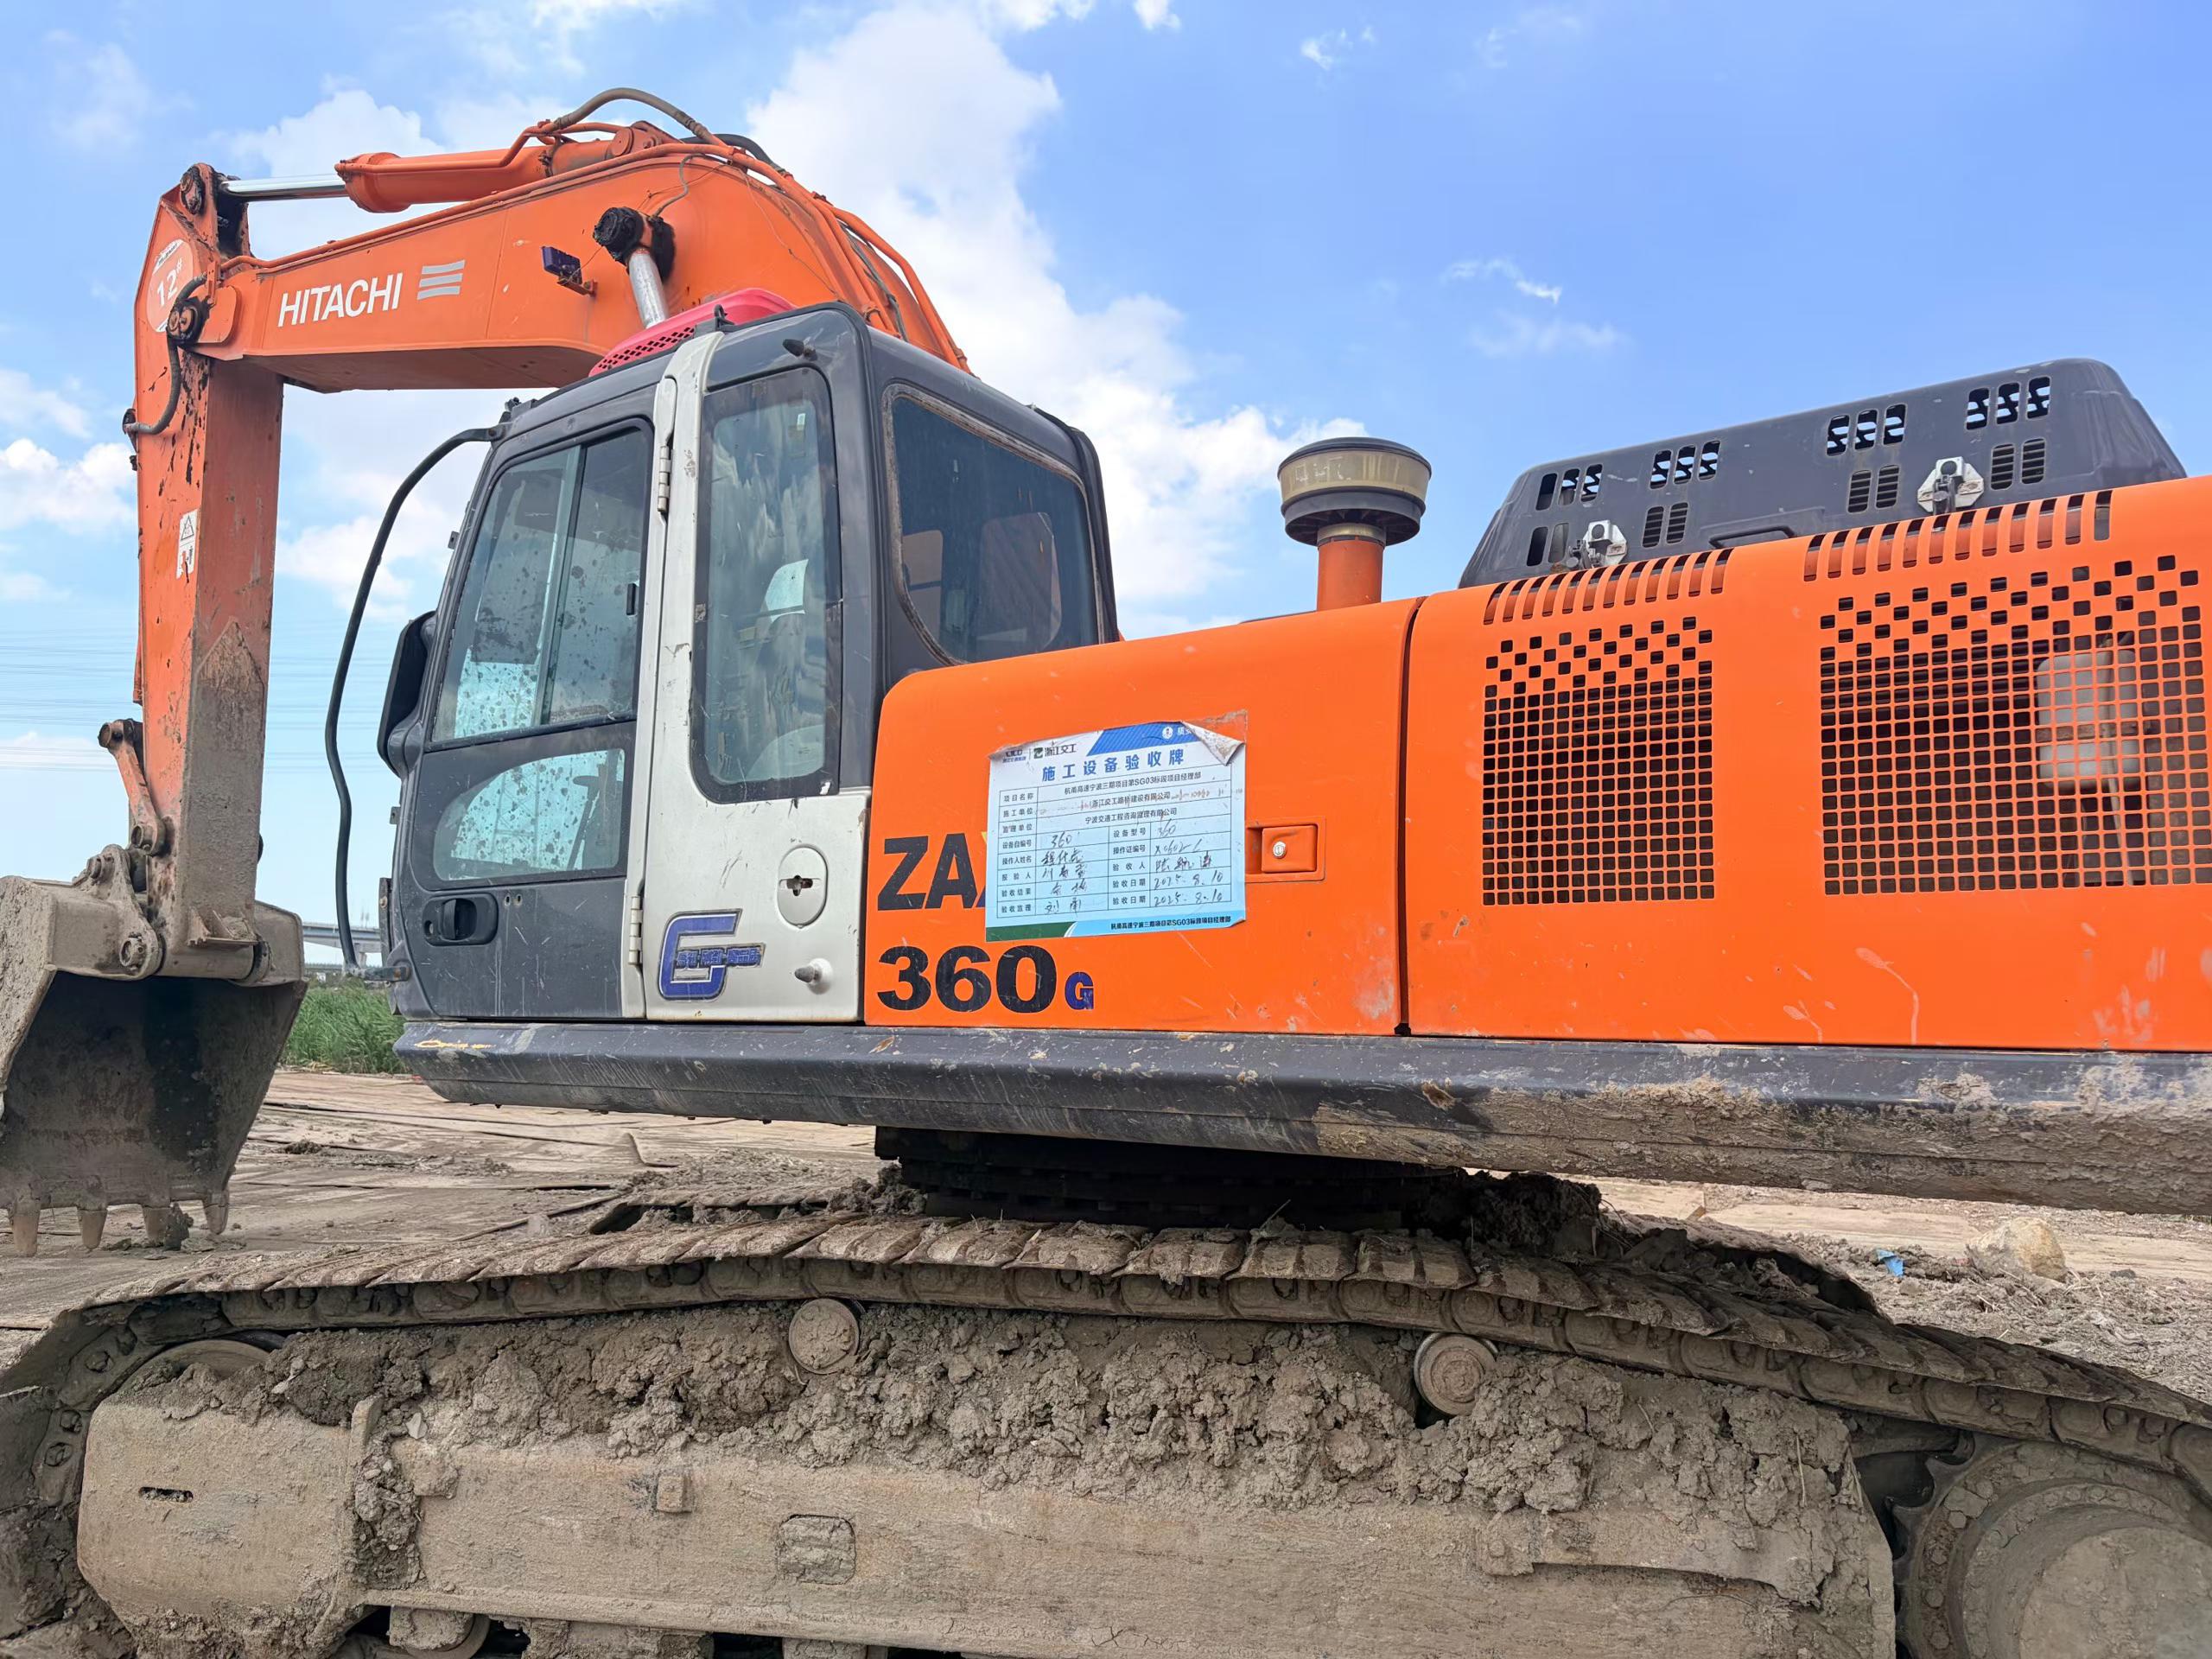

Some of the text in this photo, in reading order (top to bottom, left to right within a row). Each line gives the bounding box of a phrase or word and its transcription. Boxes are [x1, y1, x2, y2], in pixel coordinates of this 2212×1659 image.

[157, 257, 183, 307] 12#
[277, 272, 404, 327] HITACHI
[1045, 744, 1077, 758] 浙江交工
[1041, 748, 1184, 782] 施工设备验收牌
[1003, 792, 1034, 803] 项目名称
[1002, 807, 1033, 818] 施工单位
[1113, 827, 1147, 838] 设备型号
[1002, 839, 1033, 849] 设备自编号
[1051, 831, 1072, 849] 360
[1113, 844, 1147, 855] 操作证编号
[1002, 855, 1033, 865] 操作人姓名
[877, 832, 986, 912] ZA
[1113, 861, 1147, 872] 验收人
[1002, 871, 1032, 881] 报验人
[1113, 878, 1147, 888] 验收日期
[1001, 887, 1032, 898] 验收结果
[1113, 895, 1147, 906] 验收日期
